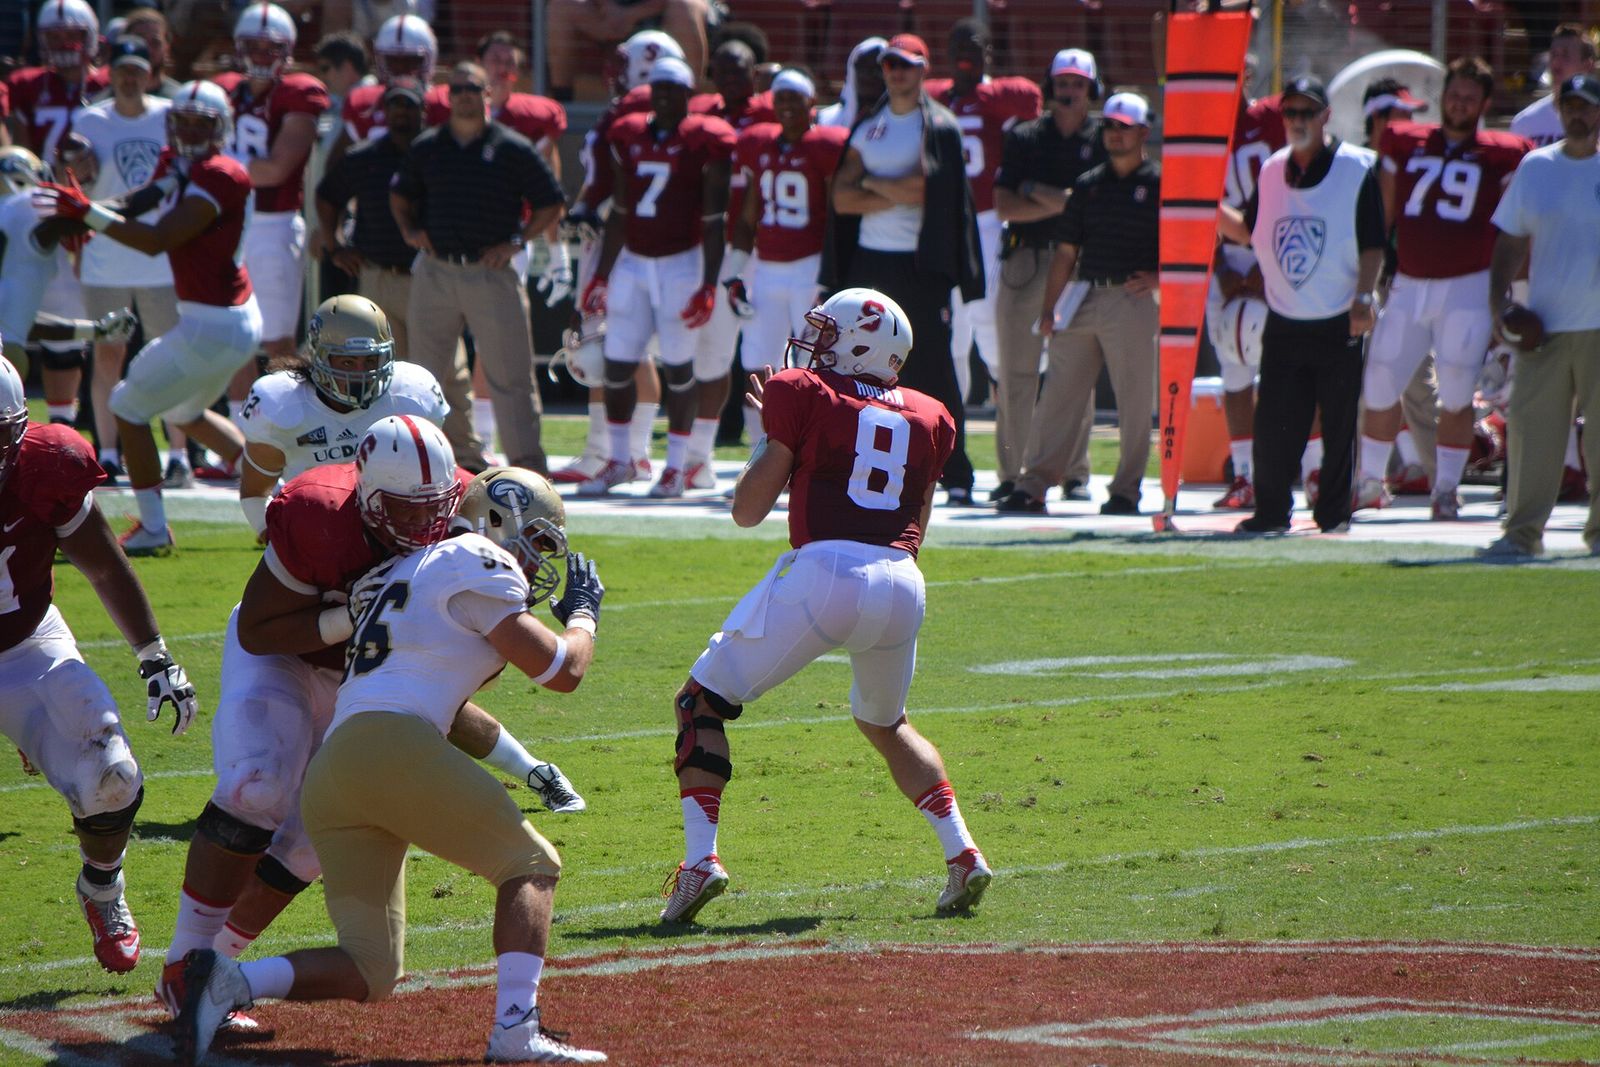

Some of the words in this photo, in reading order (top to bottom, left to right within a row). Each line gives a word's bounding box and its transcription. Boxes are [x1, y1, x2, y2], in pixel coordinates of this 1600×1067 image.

[35, 106, 82, 165] 7
[957, 116, 985, 177] 5
[636, 161, 670, 217] 7
[760, 169, 809, 229] 19
[1404, 156, 1481, 222] 79
[1286, 254, 1307, 274] 12
[847, 405, 911, 511] 8
[348, 579, 412, 676] 6
